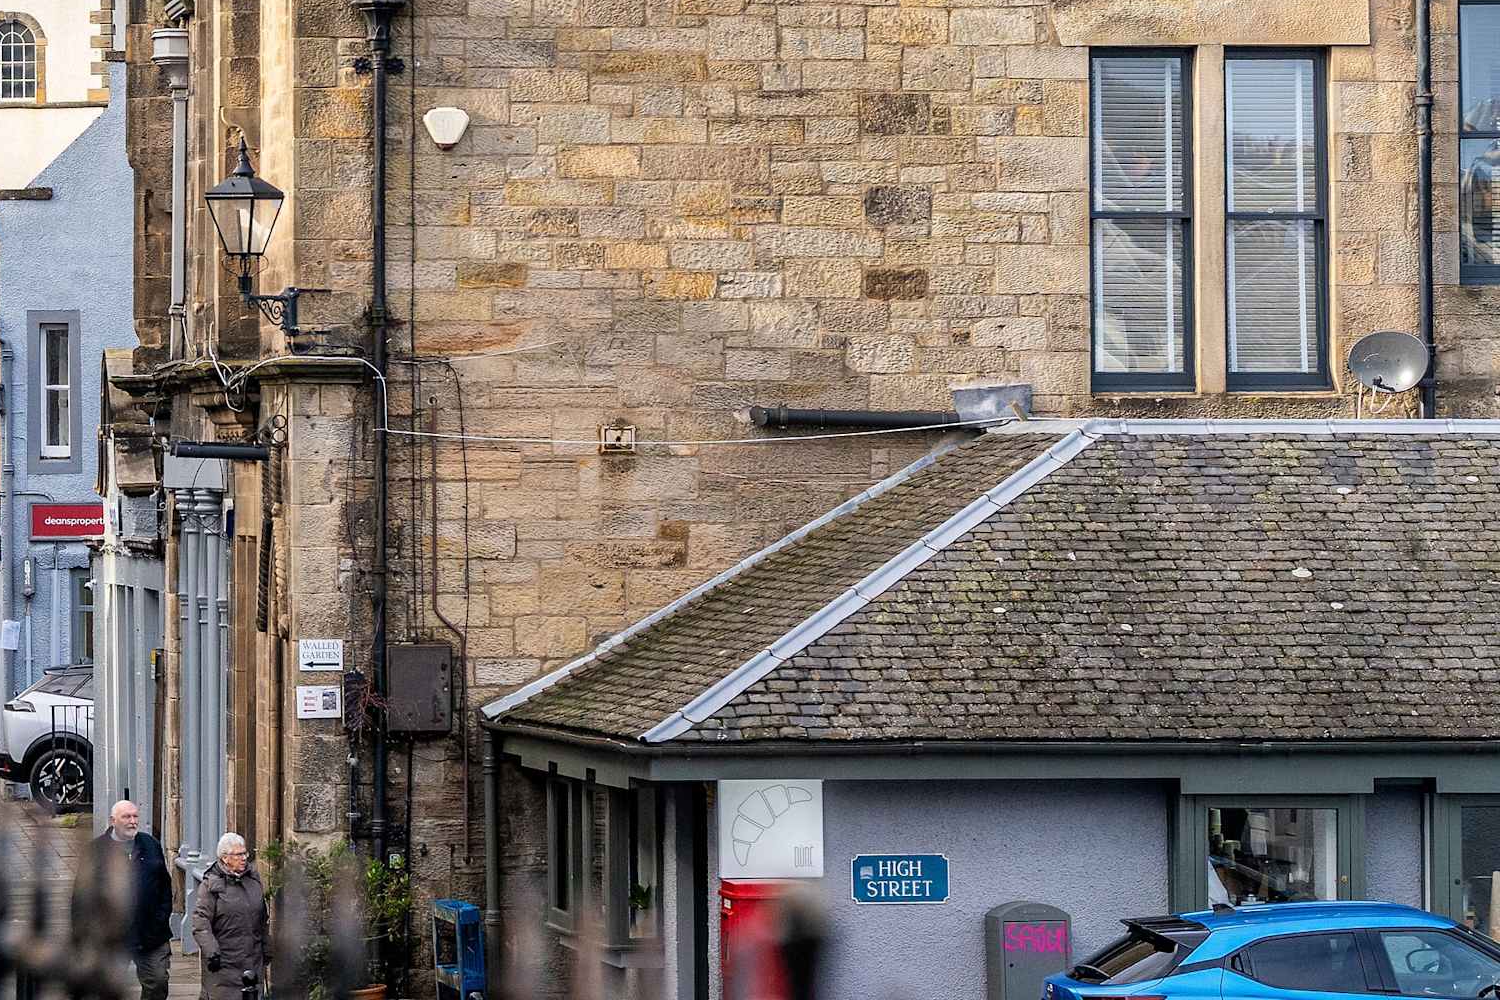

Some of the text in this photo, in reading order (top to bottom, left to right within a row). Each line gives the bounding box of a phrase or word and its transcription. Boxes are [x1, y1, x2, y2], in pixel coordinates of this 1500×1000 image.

[302, 641, 339, 650] WALLED
[302, 651, 340, 660] GARDEN
[878, 860, 922, 877] HIGH
[867, 880, 933, 898] STREET
